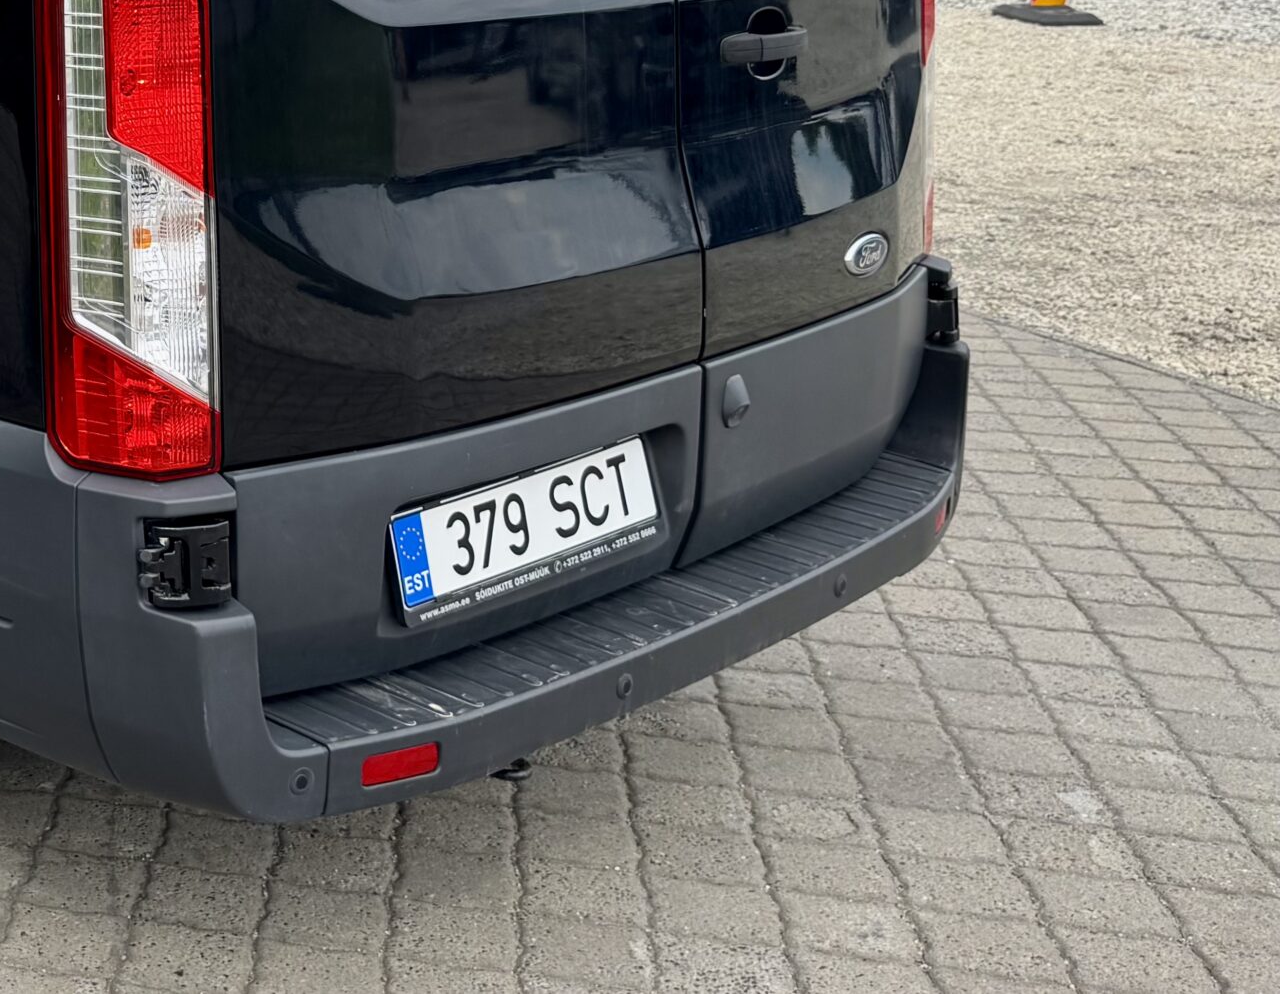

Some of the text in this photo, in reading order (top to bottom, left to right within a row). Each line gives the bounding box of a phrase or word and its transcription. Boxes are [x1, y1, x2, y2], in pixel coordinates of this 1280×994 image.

[859, 242, 882, 268] Ford
[446, 453, 626, 576] 379 SCT
[404, 569, 431, 596] EST
[419, 597, 471, 621] www.asmo.ee
[563, 555, 580, 568] +372
